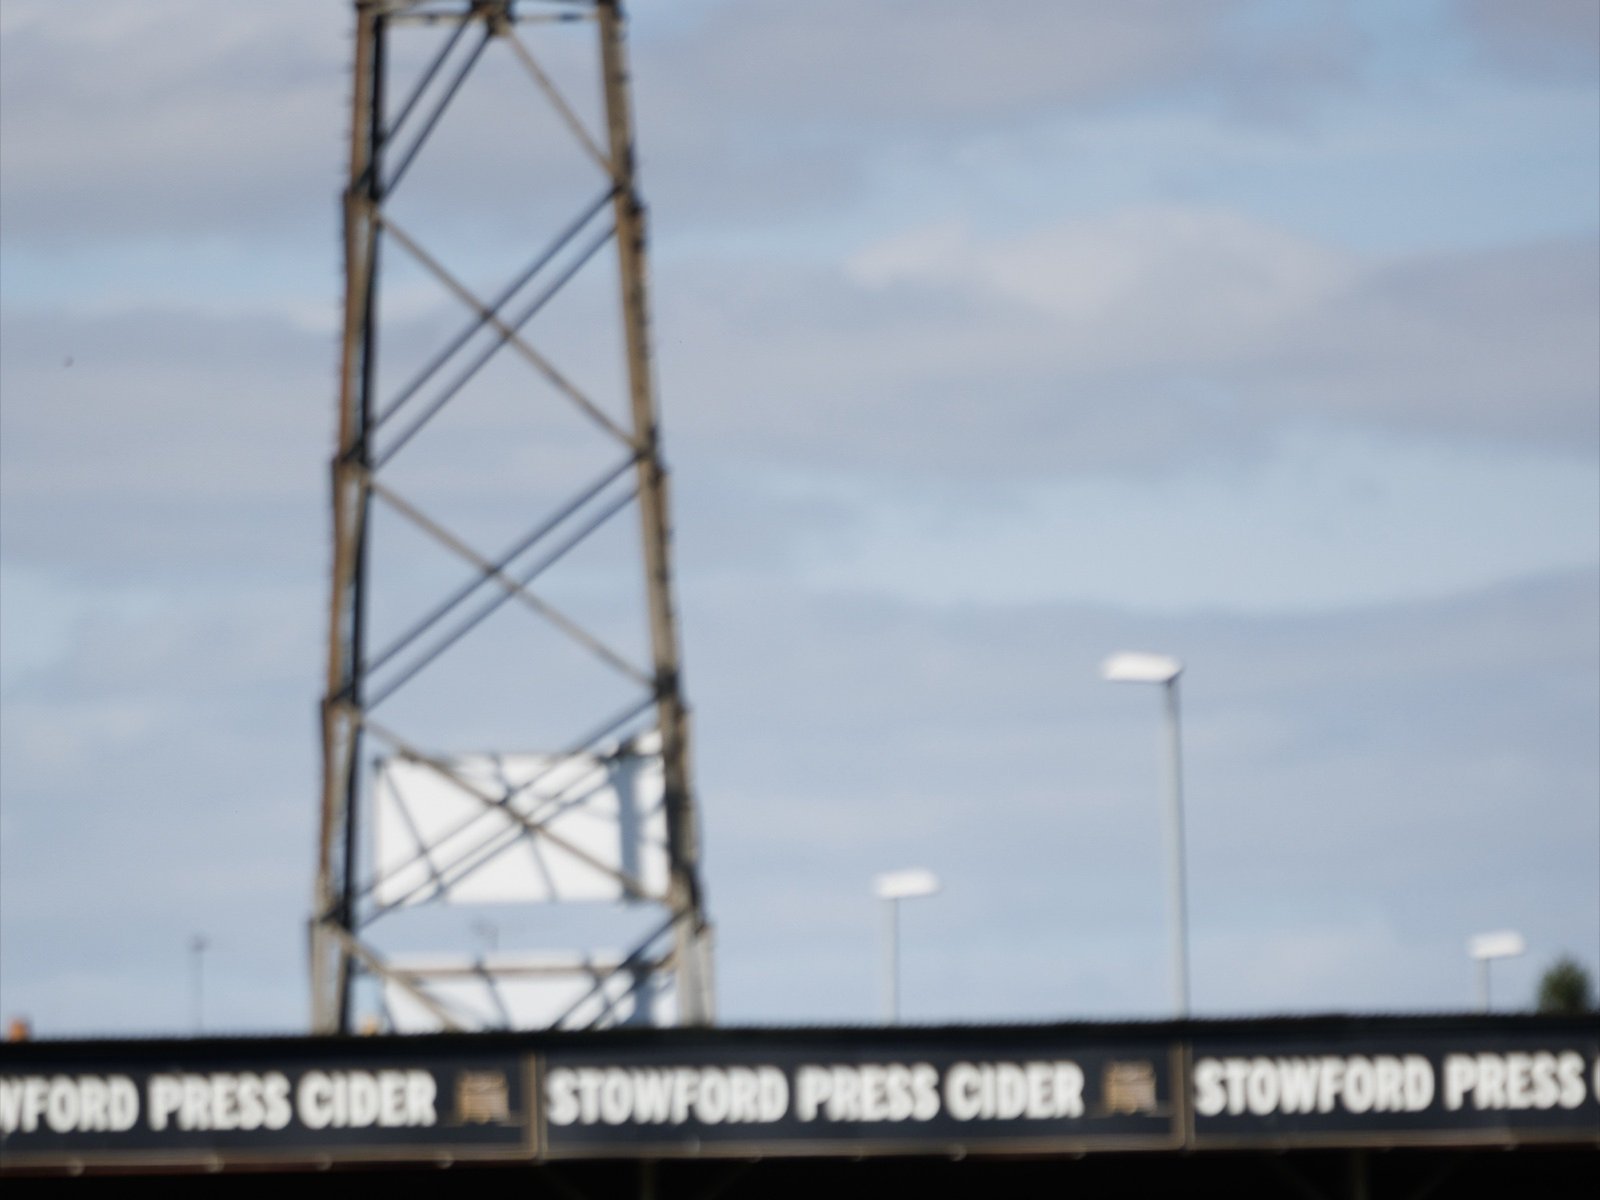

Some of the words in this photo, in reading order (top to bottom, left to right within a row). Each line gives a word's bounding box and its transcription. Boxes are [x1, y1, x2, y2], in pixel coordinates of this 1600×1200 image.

[148, 1070, 292, 1132] PRESS
[297, 1067, 437, 1130] CIDER
[546, 1064, 789, 1126] STOWFORD
[796, 1062, 940, 1123] PRESS
[945, 1060, 1085, 1122] CIDER
[1194, 1055, 1435, 1117] STOWFORD
[1443, 1050, 1586, 1111] PRESS
